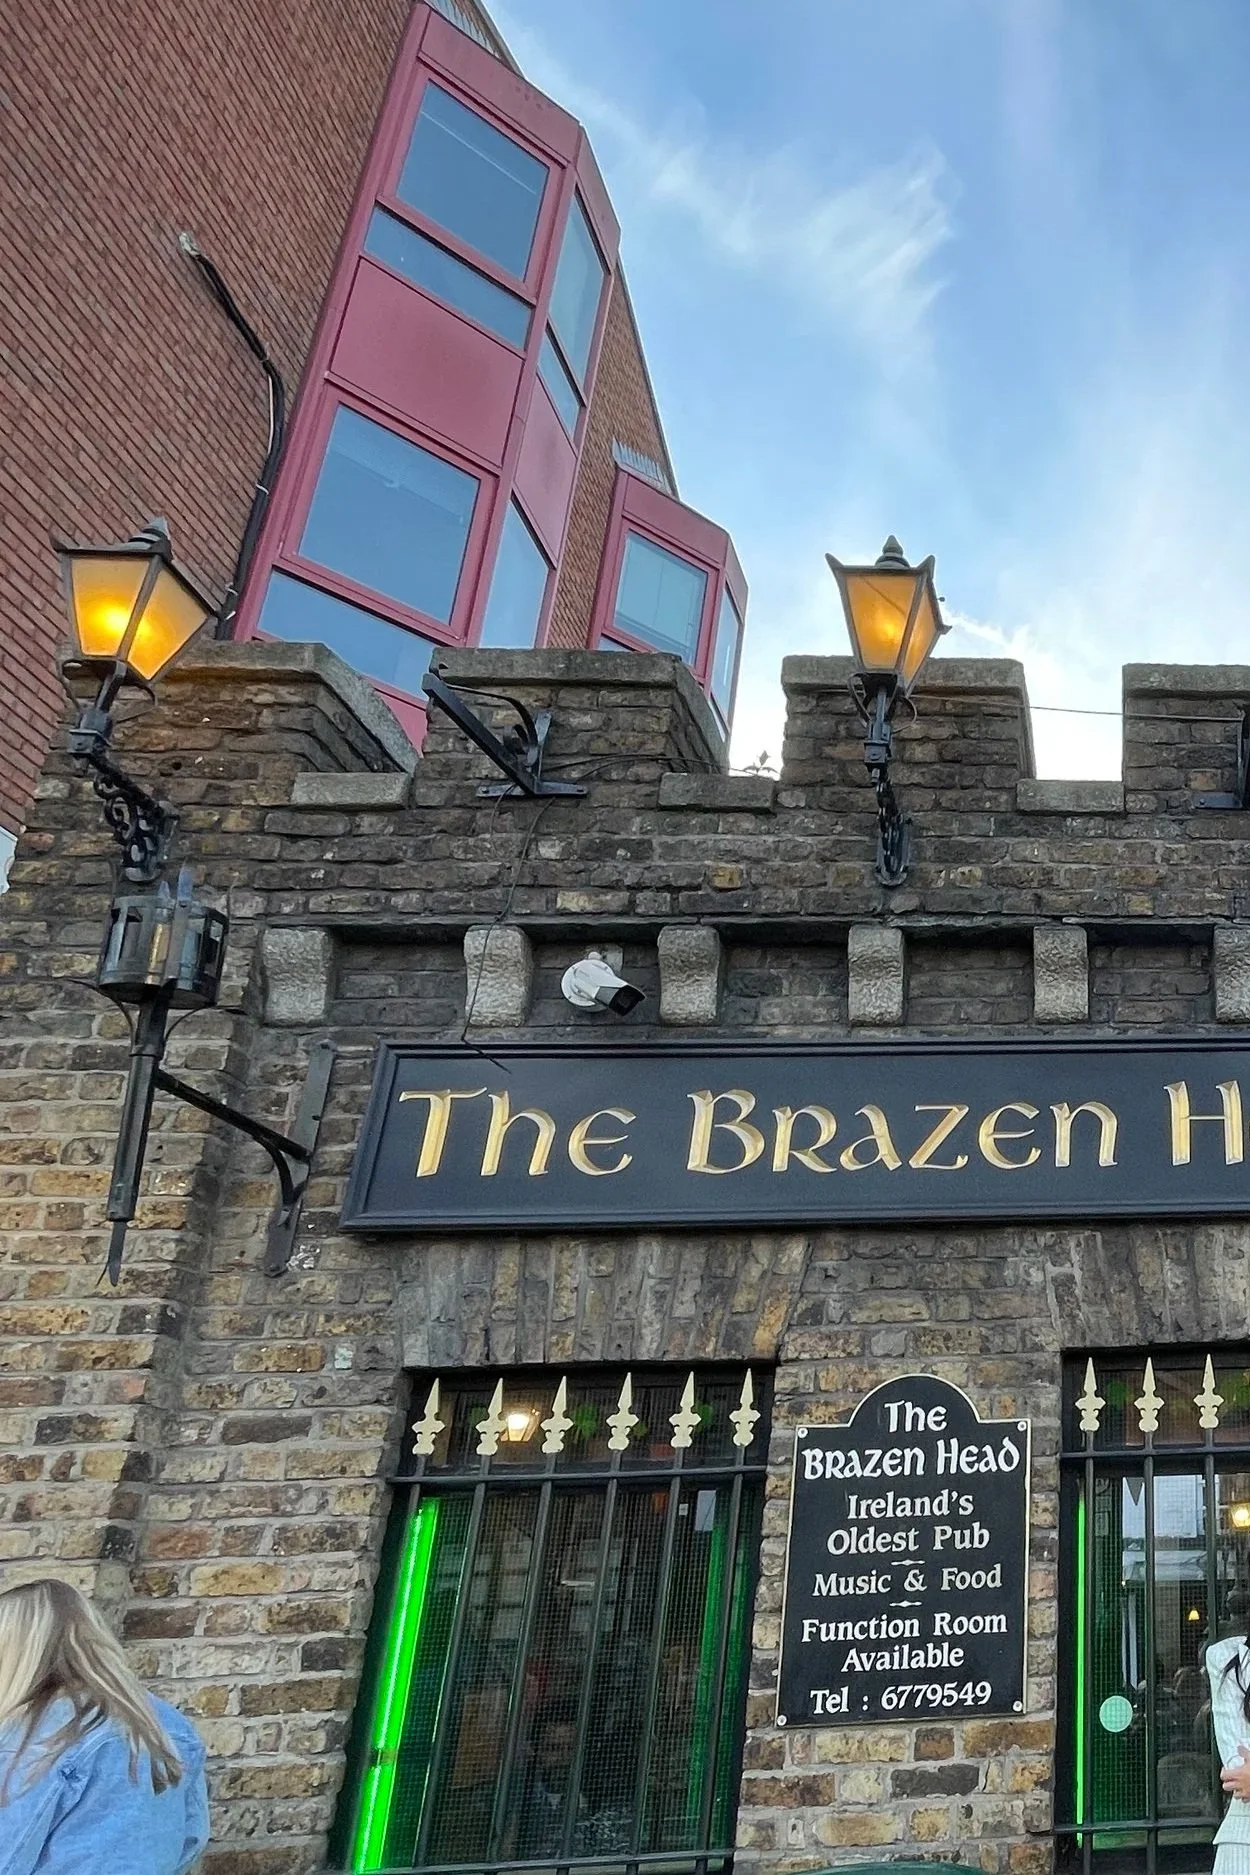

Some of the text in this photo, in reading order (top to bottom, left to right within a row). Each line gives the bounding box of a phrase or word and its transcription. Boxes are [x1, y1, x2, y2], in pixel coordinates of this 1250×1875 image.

[399, 1087, 637, 1177] The
[687, 1089, 1118, 1174] Brazen
[884, 1401, 947, 1433] The
[936, 1437, 1020, 1475] Head
[848, 1489, 974, 1520] Ireland's
[827, 1521, 990, 1556] Oldest Pub
[812, 1564, 1003, 1597] Music & Food
[801, 1612, 1008, 1643] Function Room
[841, 1642, 965, 1673] Available
[810, 1681, 992, 1714] Tel : 6779549
